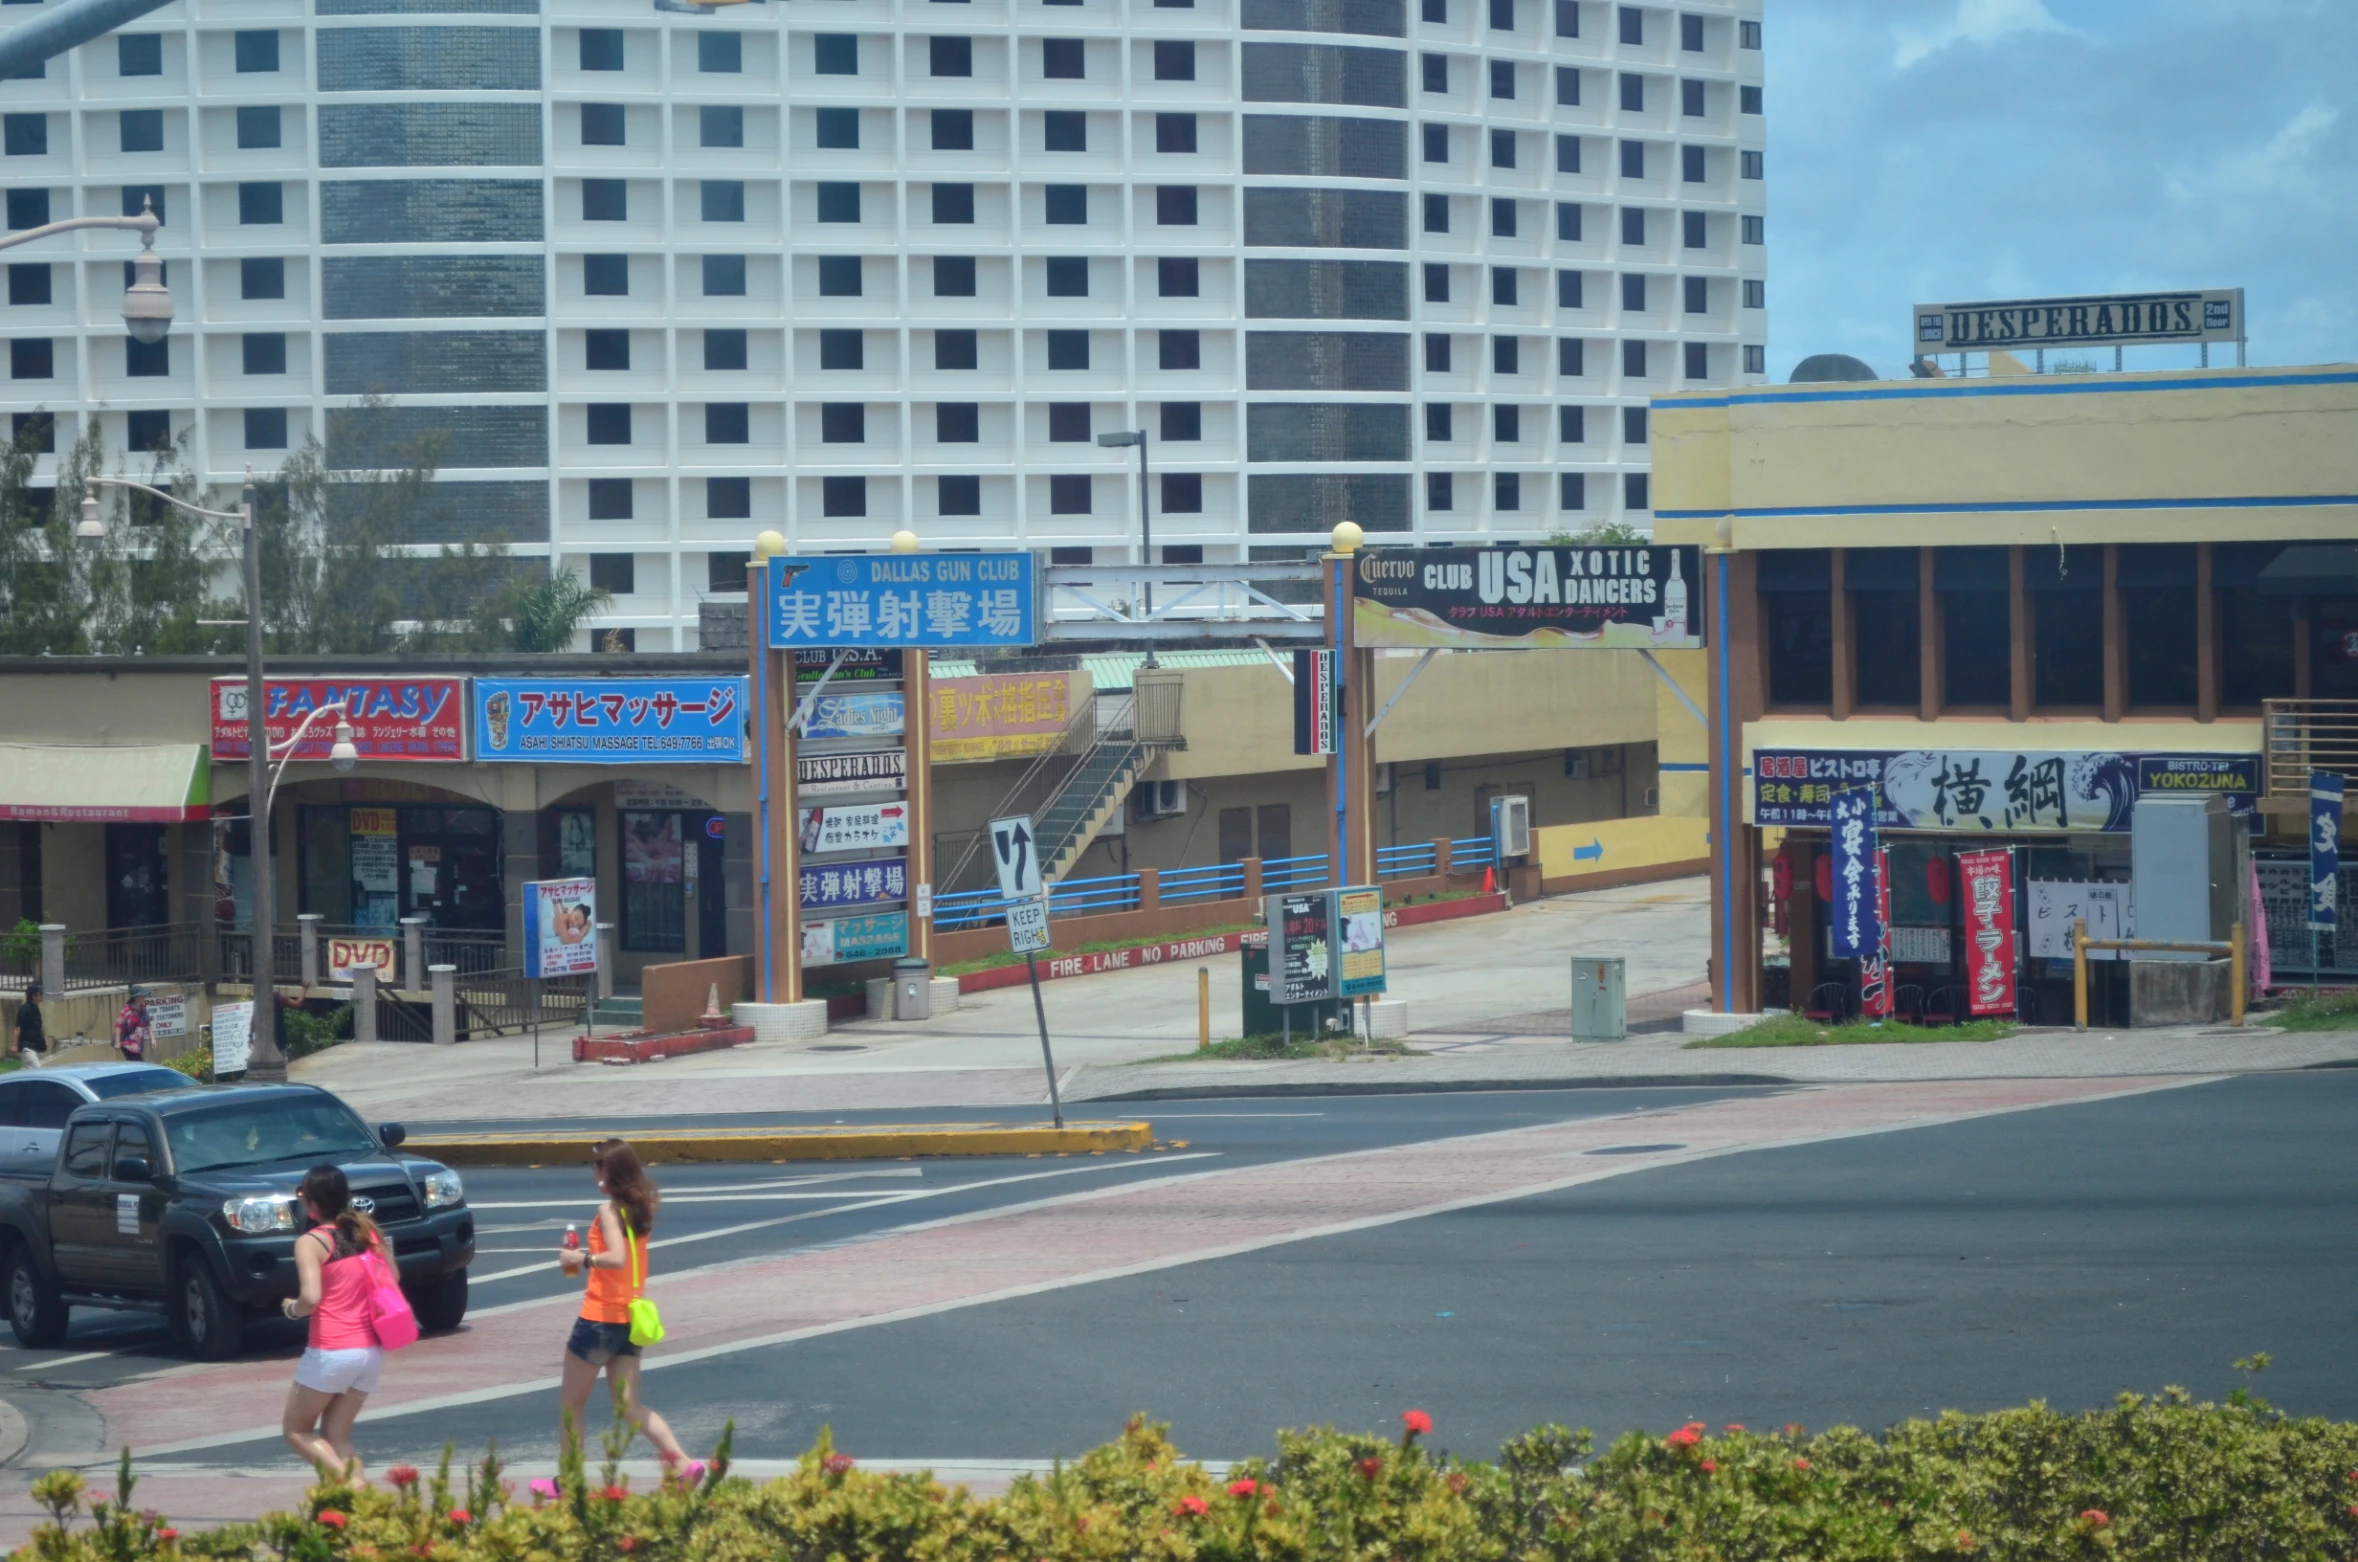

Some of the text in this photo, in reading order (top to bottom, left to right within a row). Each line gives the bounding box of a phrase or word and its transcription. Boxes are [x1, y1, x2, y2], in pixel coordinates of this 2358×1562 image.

[2206, 303, 2229, 316] 2nd
[1951, 301, 2192, 342] DESPERADOS
[2206, 316, 2229, 329] floor
[1921, 328, 1942, 341] LUNCH
[871, 560, 1020, 583] DALLAS GUN CLUB
[1360, 554, 1415, 584] Cuervo
[1424, 564, 1473, 590] CLUB
[1478, 551, 1561, 604] USA
[1372, 588, 1408, 596] TEQUILA
[1565, 579, 1656, 604] DANCERS
[1449, 607, 1477, 619] クラブ
[1480, 607, 1504, 619] USA
[796, 650, 827, 664] CLUB
[796, 669, 852, 681] entlean's
[854, 668, 876, 679] Club
[268, 686, 451, 725] FANTASY
[518, 687, 736, 730] アサヒマッサージ
[1320, 652, 1329, 749] DESPERADOS
[816, 698, 898, 732] Ladies Night
[520, 736, 548, 750] ASAHI
[551, 736, 589, 750] SHIATSU
[593, 736, 639, 750] MASSAGE
[799, 755, 902, 781] DESPERADOS
[810, 780, 892, 793] Restaurant & Cantina
[2149, 772, 2248, 789] YOKOZUNA
[1931, 754, 2069, 830] 横綱
[353, 811, 380, 831] DVD
[1012, 907, 1041, 927] KEEP
[1293, 903, 1310, 914] USA
[835, 914, 905, 935] マッサージ
[839, 932, 902, 948] MASSAGE
[1970, 874, 2007, 1003] 餃子・ラーメン
[333, 942, 391, 969] DVD
[1051, 937, 1226, 978] FIRE LANE NO PARKING
[145, 996, 184, 1007] PARKING
[156, 1021, 172, 1029] ONLY
